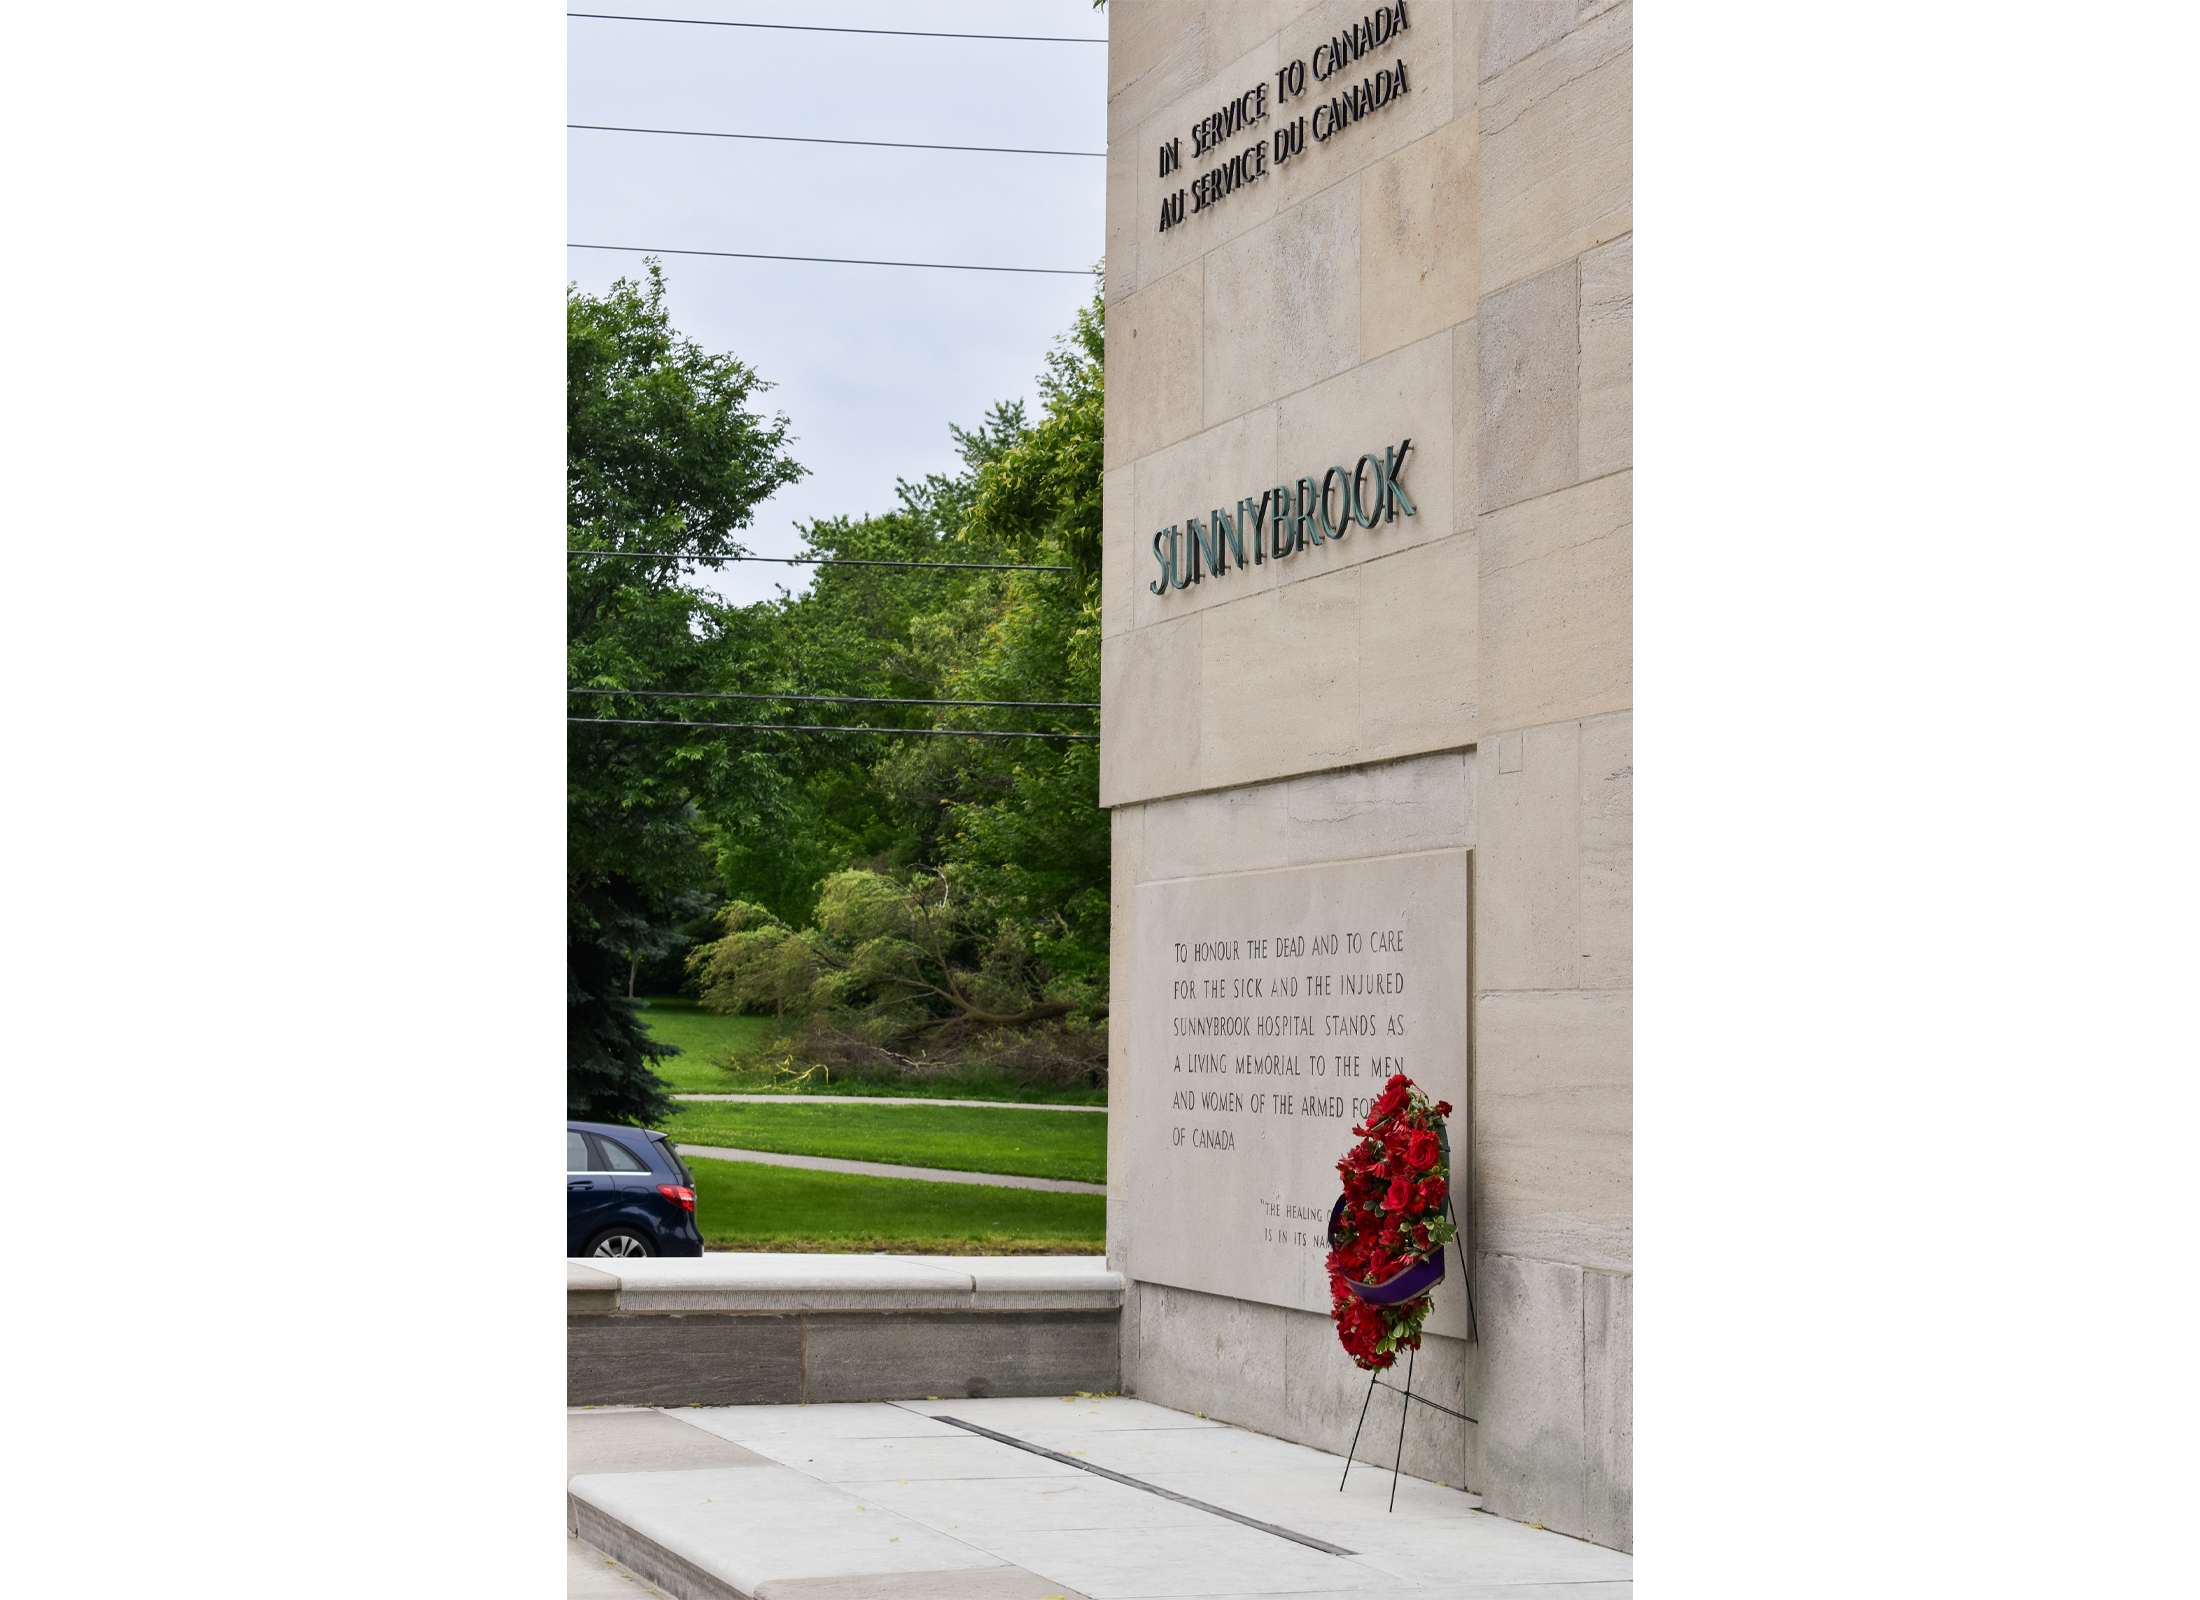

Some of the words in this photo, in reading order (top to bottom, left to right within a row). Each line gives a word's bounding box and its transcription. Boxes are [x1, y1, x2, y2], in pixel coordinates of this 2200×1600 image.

[1159, 137, 1179, 178] IN
[1191, 83, 1267, 158] SERVICE
[1275, 59, 1304, 104] TO
[1312, 0, 1408, 81] CANADA
[1159, 189, 1185, 232] AU
[1191, 140, 1267, 214] SERVICE
[1274, 116, 1304, 165] DU
[1312, 59, 1408, 142] CANADA
[1150, 438, 1416, 595] SUNNYBROOK
[1174, 942, 1188, 963] TO
[1194, 940, 1240, 962] HONOUR
[1247, 939, 1268, 960] THE
[1276, 935, 1305, 958] DEAD
[1311, 933, 1339, 956] AND
[1346, 932, 1362, 954] TO
[1370, 930, 1404, 953] CARE
[1173, 980, 1197, 1000] FOR
[1204, 979, 1226, 999] THE
[1233, 978, 1263, 998] SICK
[1270, 976, 1298, 998] AND
[1306, 975, 1331, 996] THE
[1340, 972, 1404, 996] INJURED
[1173, 1016, 1250, 1036] SUNNYBROOK
[1257, 1015, 1315, 1036] HOSPITAL
[1325, 1014, 1376, 1036] STANDS
[1386, 1013, 1404, 1036] AS
[1173, 1054, 1181, 1073] A
[1188, 1053, 1227, 1074] LIVING
[1235, 1054, 1300, 1076] MEMORIAL
[1309, 1055, 1326, 1077] TO
[1334, 1055, 1360, 1077] THE
[1371, 1056, 1404, 1077] MEN
[1172, 1090, 1195, 1110] AND
[1201, 1091, 1243, 1112] WOMEN
[1250, 1093, 1265, 1114] OF
[1272, 1093, 1294, 1115] THE
[1301, 1095, 1344, 1118] ARMED
[1172, 1127, 1186, 1146] OF
[1192, 1128, 1236, 1150] CANADA
[1286, 1205, 1323, 1222] HEALING
[1264, 1227, 1273, 1242] IS
[1278, 1229, 1288, 1244] IN
[1293, 1231, 1307, 1247] ITS
